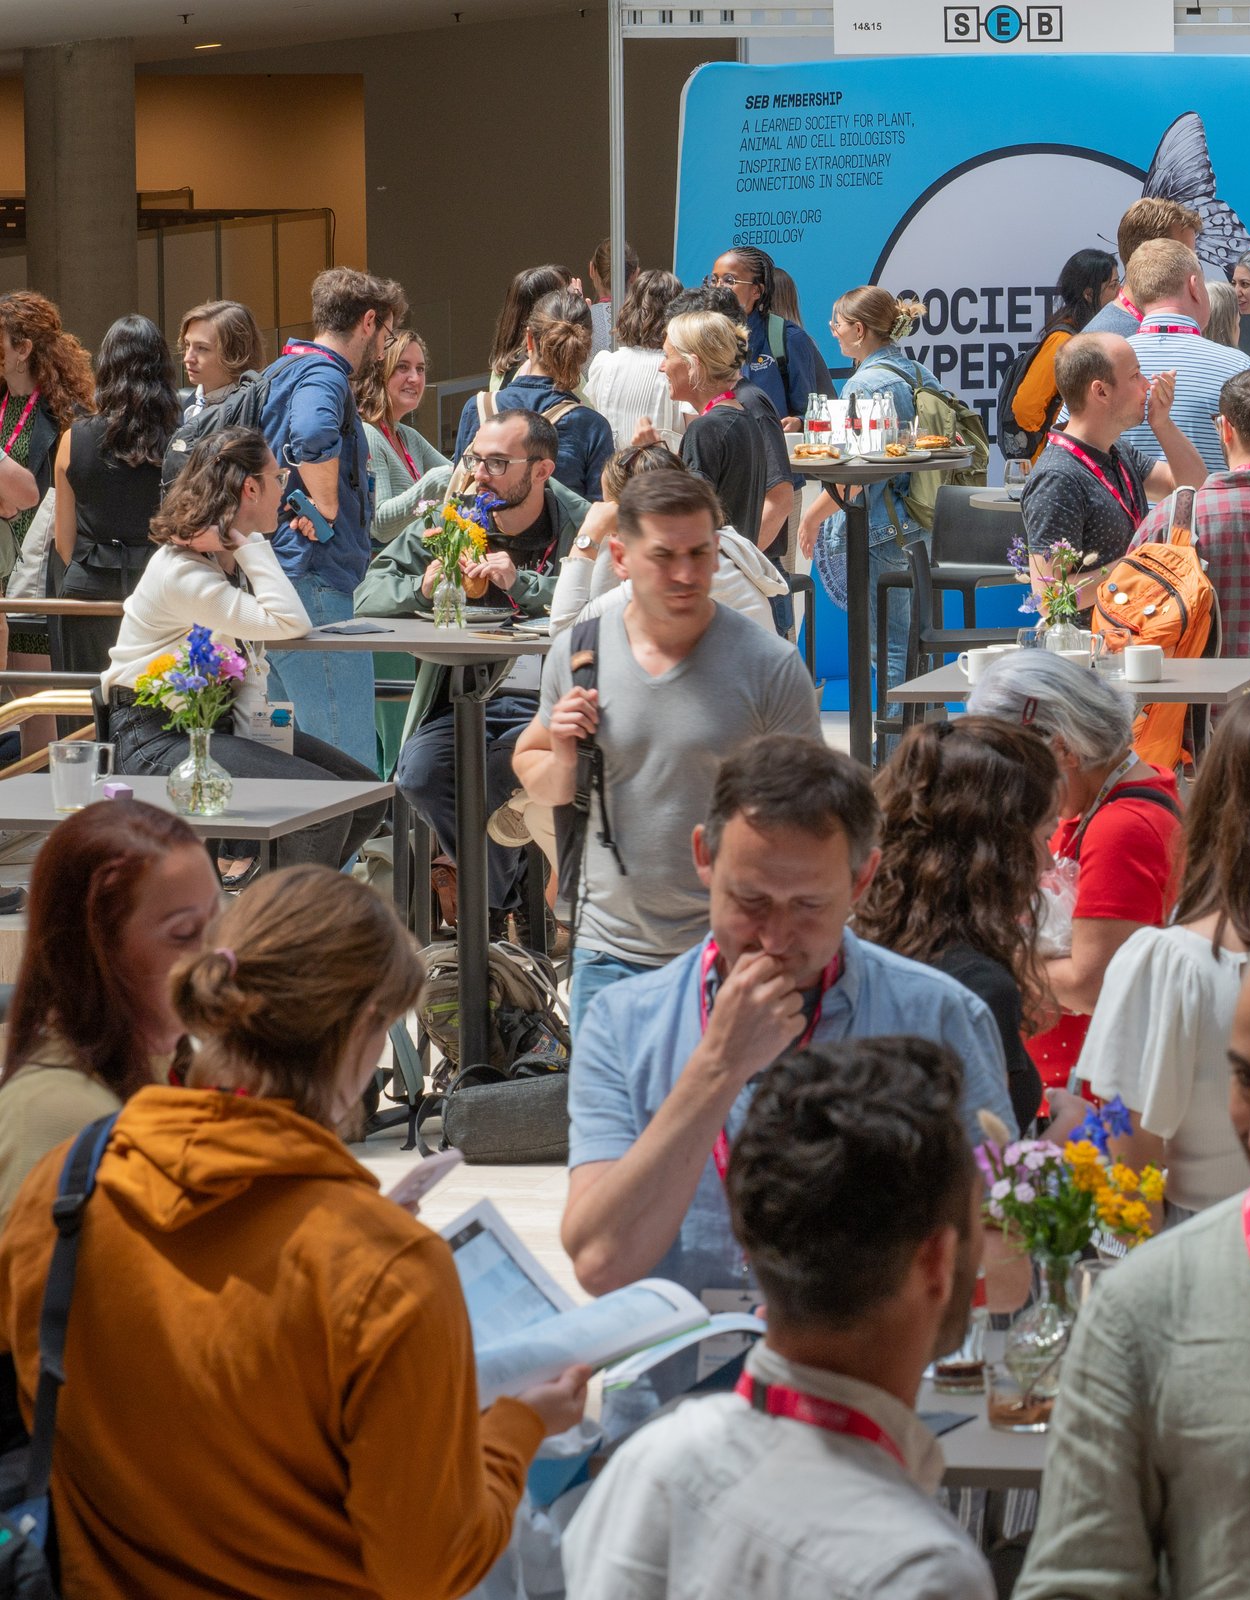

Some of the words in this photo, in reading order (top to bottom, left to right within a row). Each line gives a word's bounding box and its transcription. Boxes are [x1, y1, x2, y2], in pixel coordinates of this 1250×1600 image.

[852, 22, 882, 31] 14&15
[951, 10, 1056, 39] SEB
[745, 94, 770, 110] SEB
[772, 91, 843, 109] MEMBERSHIP
[741, 119, 750, 134] A
[754, 117, 802, 133] LEARNED
[804, 114, 850, 131] SOCIETY
[853, 113, 874, 128] FOR
[877, 112, 915, 128] PLANT,
[739, 137, 783, 152] ANIMAL
[786, 135, 808, 149] AND
[810, 133, 836, 148] CELL
[840, 130, 906, 147] BIOLOGISTS
[738, 157, 801, 174] INSPIRING
[805, 153, 892, 171] EXTRAORDINARY
[736, 175, 815, 192] CONNECTIONS
[818, 174, 833, 189] IN
[836, 171, 883, 187] SCIENCE
[734, 209, 822, 228] SEBIOLOGY.ORG
[732, 228, 805, 246] @SEBIOLOGY
[896, 286, 1062, 337] OCIET
